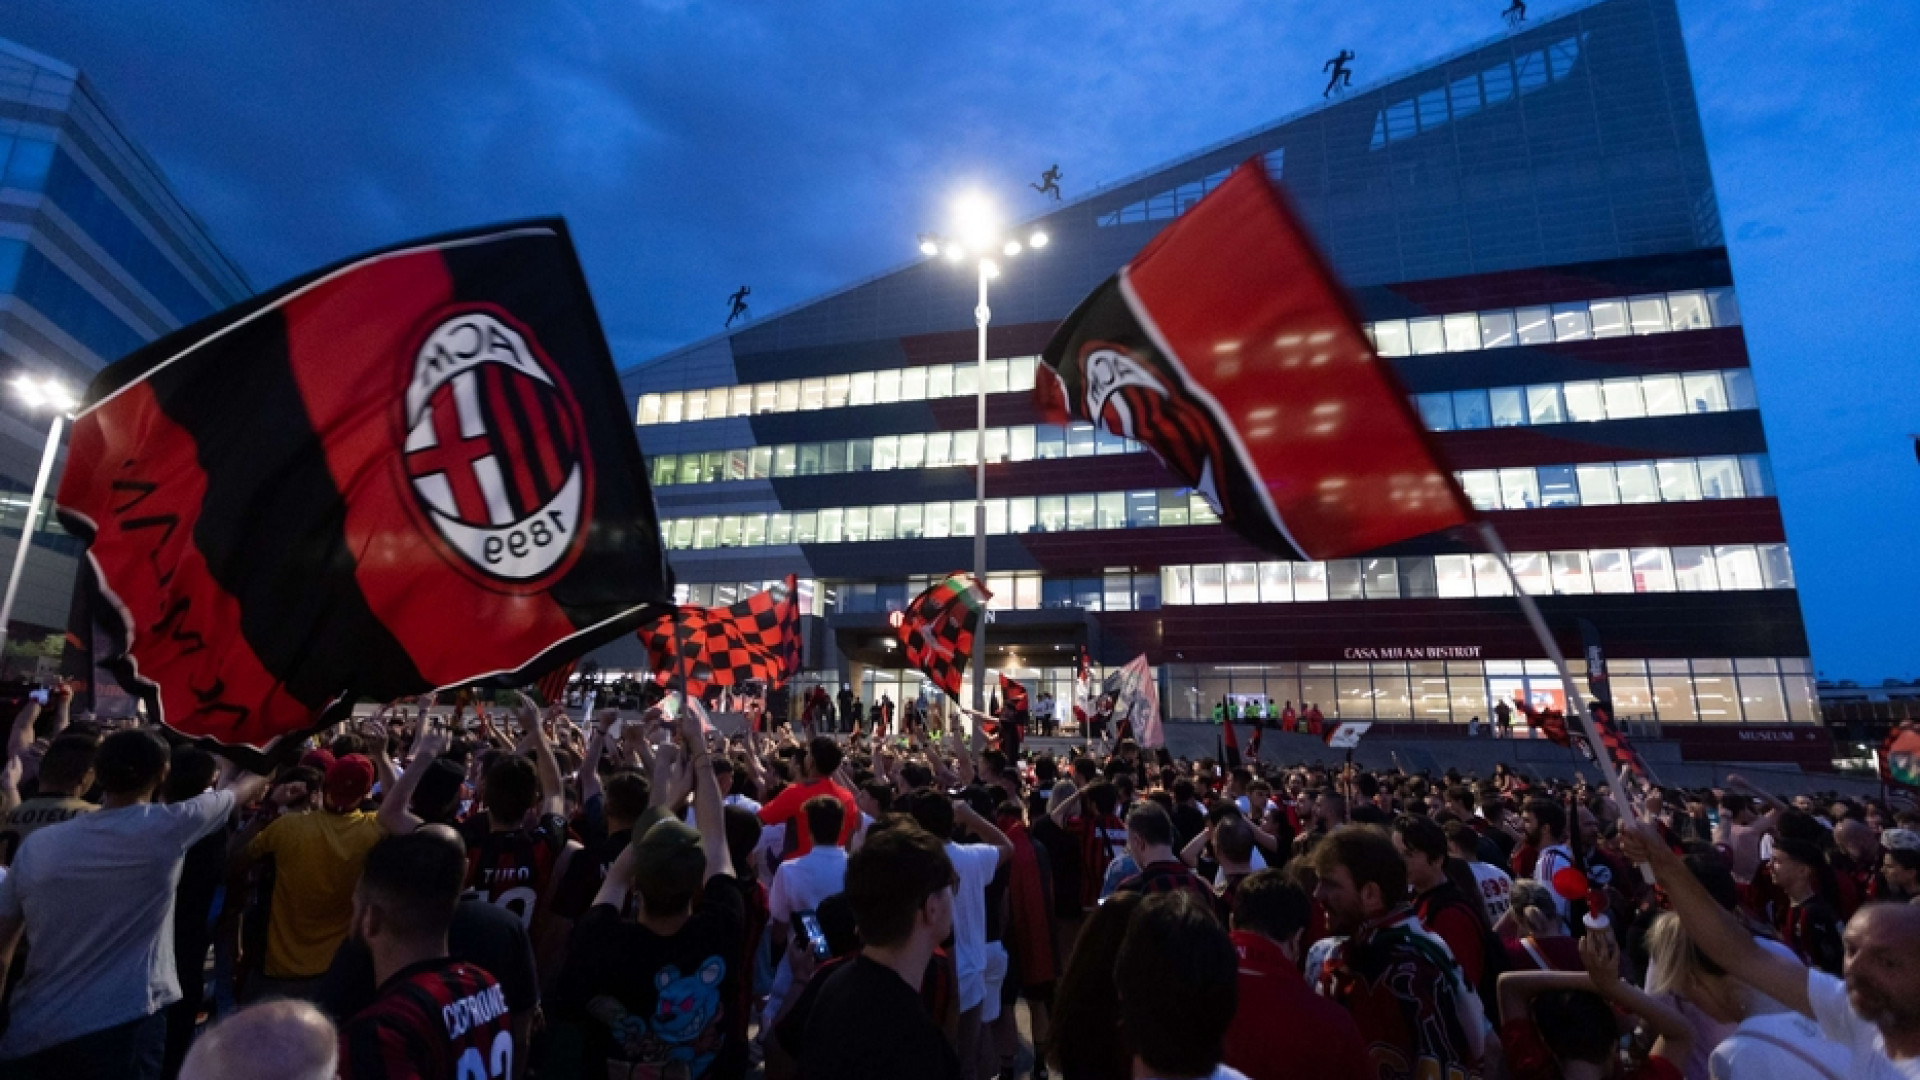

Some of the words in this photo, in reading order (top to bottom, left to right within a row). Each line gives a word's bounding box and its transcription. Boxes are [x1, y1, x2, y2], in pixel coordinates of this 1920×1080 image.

[1344, 647, 1378, 660] CASA
[1380, 647, 1424, 659] MILAN
[1738, 730, 1794, 741] MUSEUM
